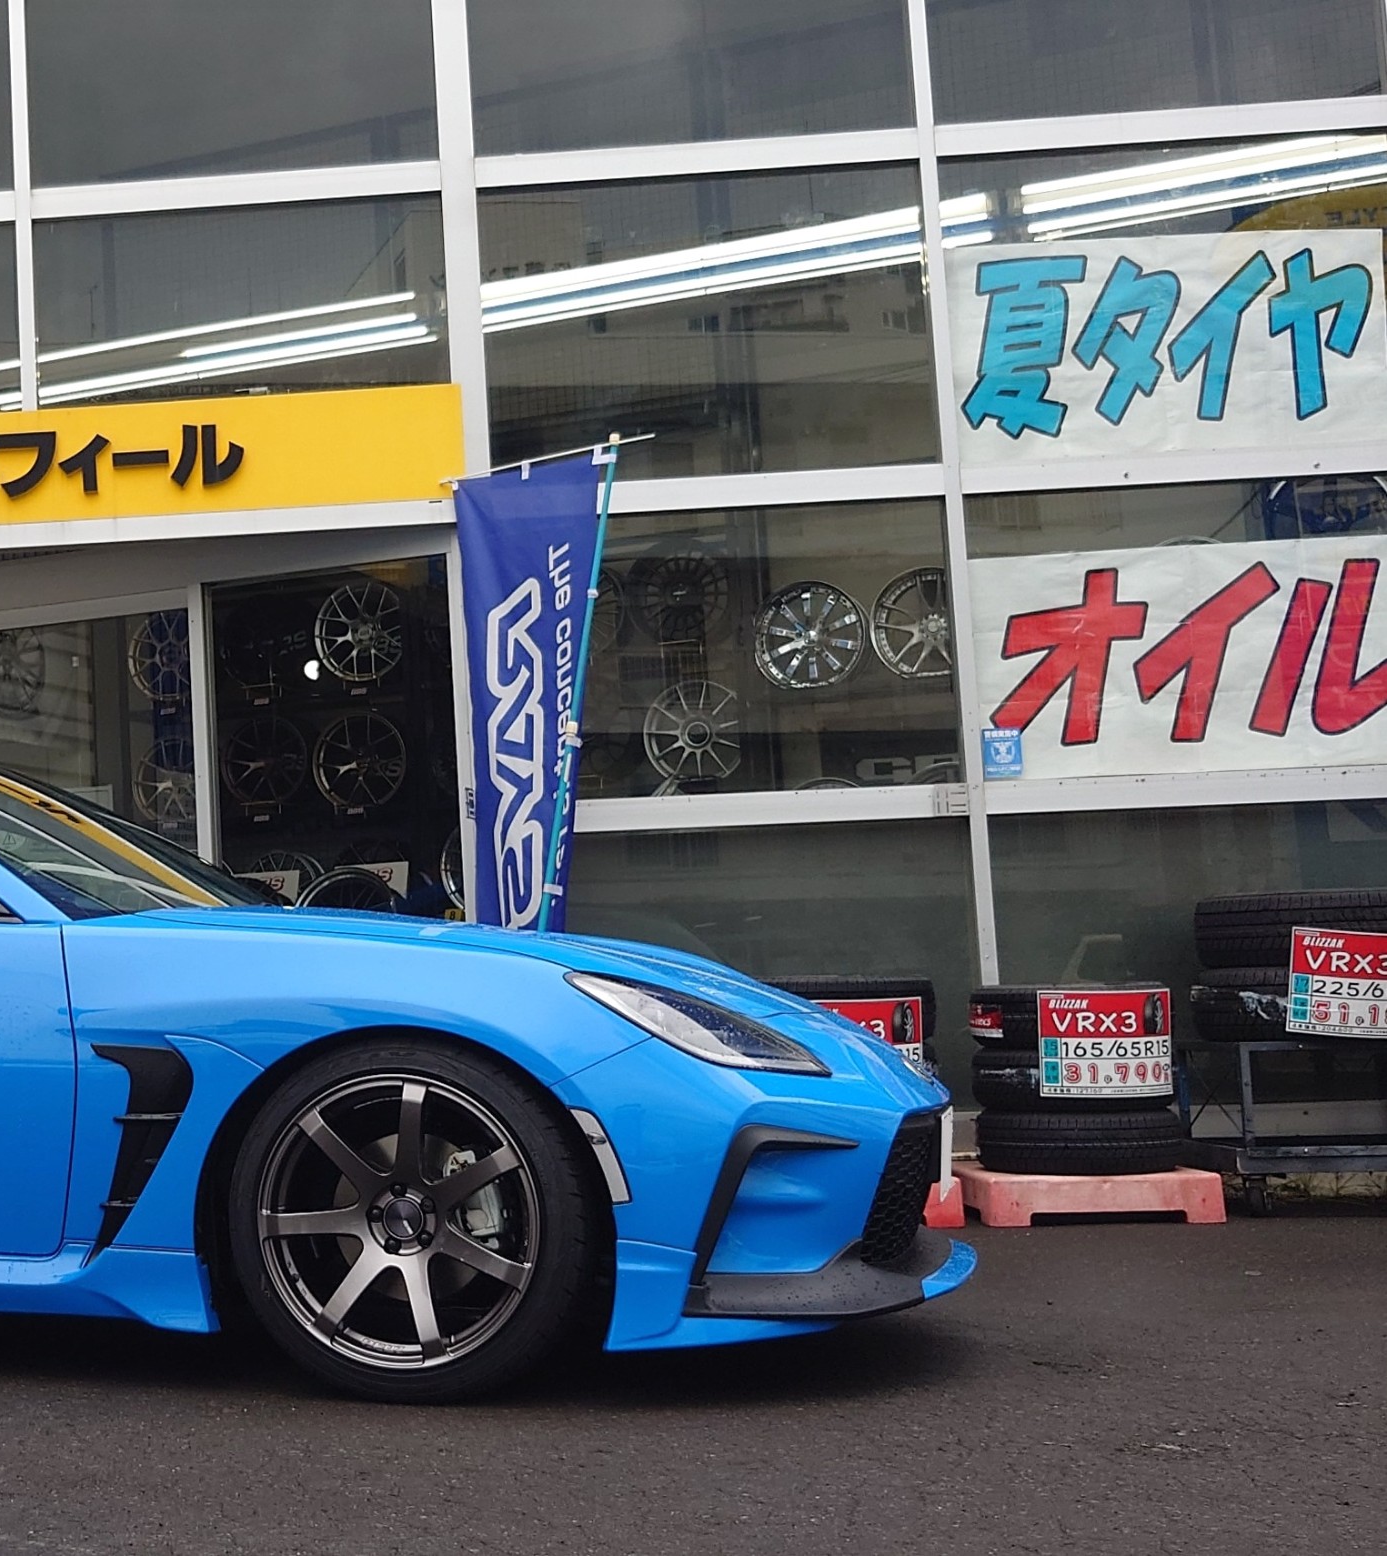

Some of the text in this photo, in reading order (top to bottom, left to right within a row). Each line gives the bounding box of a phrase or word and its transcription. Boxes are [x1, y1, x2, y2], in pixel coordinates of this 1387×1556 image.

[961, 247, 1373, 439] 夏タイヤ
[989, 558, 1387, 747] オイル
[1302, 936, 1345, 949] BLIZZAK
[1305, 949, 1387, 975] VRX3
[1049, 999, 1089, 1010] BLIZZAK
[1052, 1011, 1137, 1033] VRX3
[1062, 1039, 1169, 1057] 165/65R15
